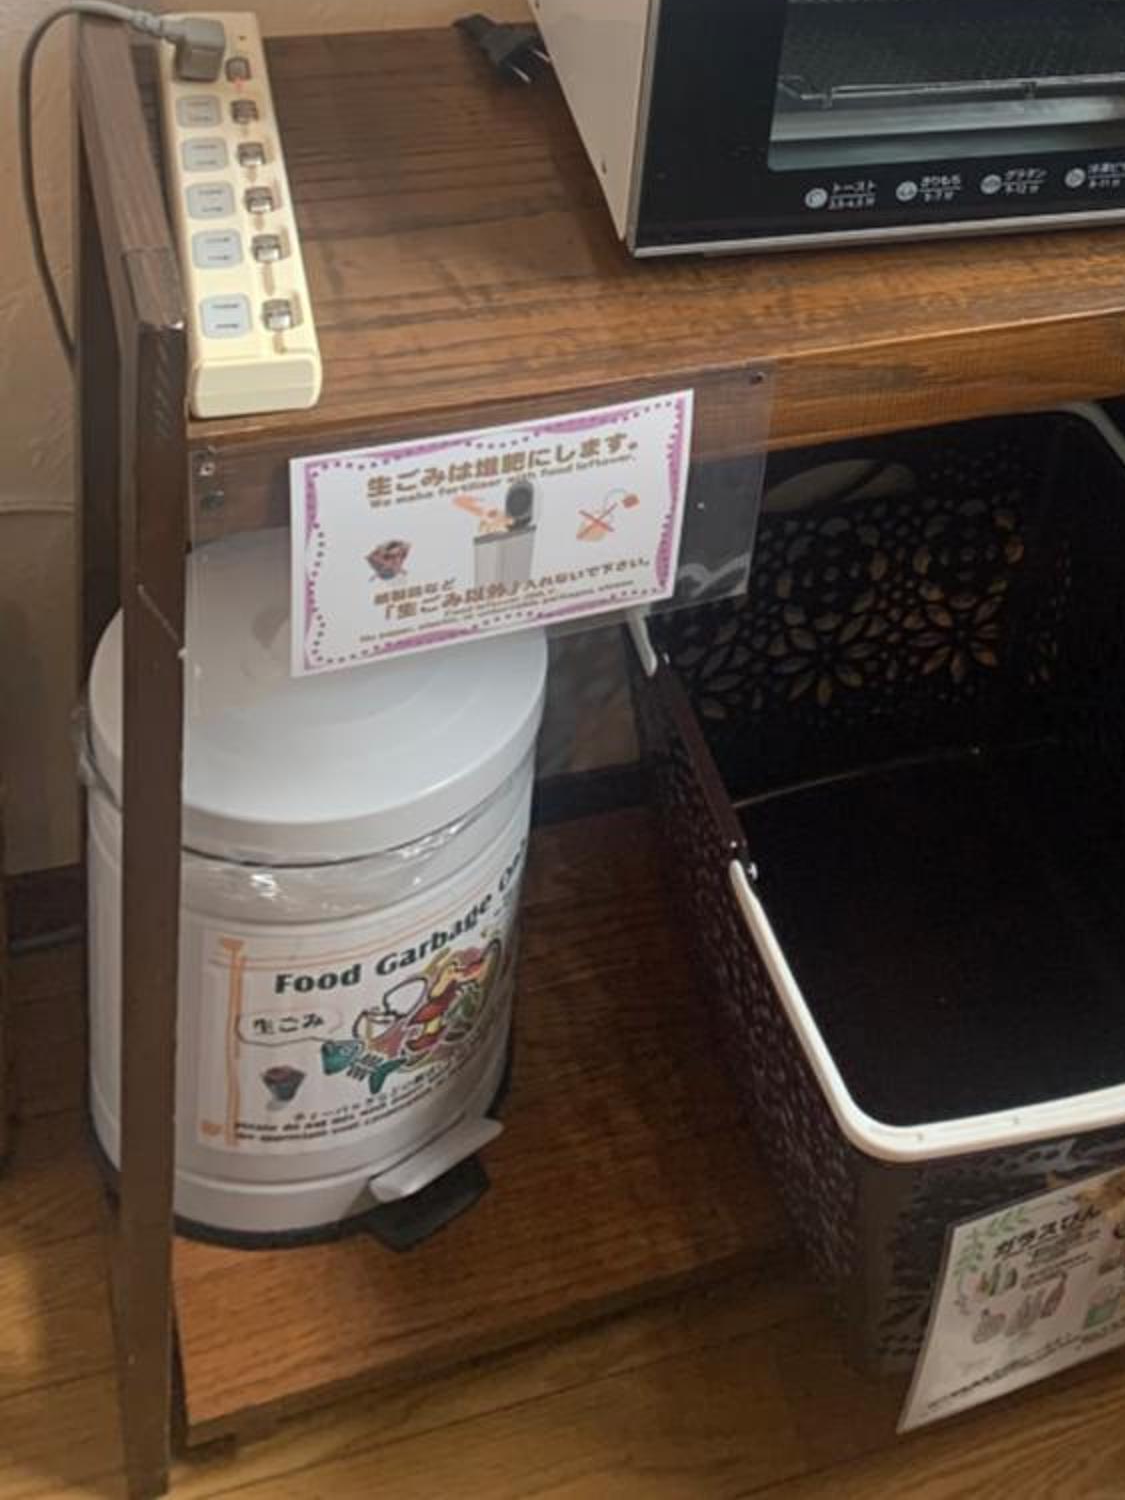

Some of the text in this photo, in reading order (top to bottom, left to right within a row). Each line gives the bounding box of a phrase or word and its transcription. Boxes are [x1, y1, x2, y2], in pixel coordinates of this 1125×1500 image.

[275, 894, 493, 994] Food Garbage
[252, 1012, 324, 1036] 生ごみ
